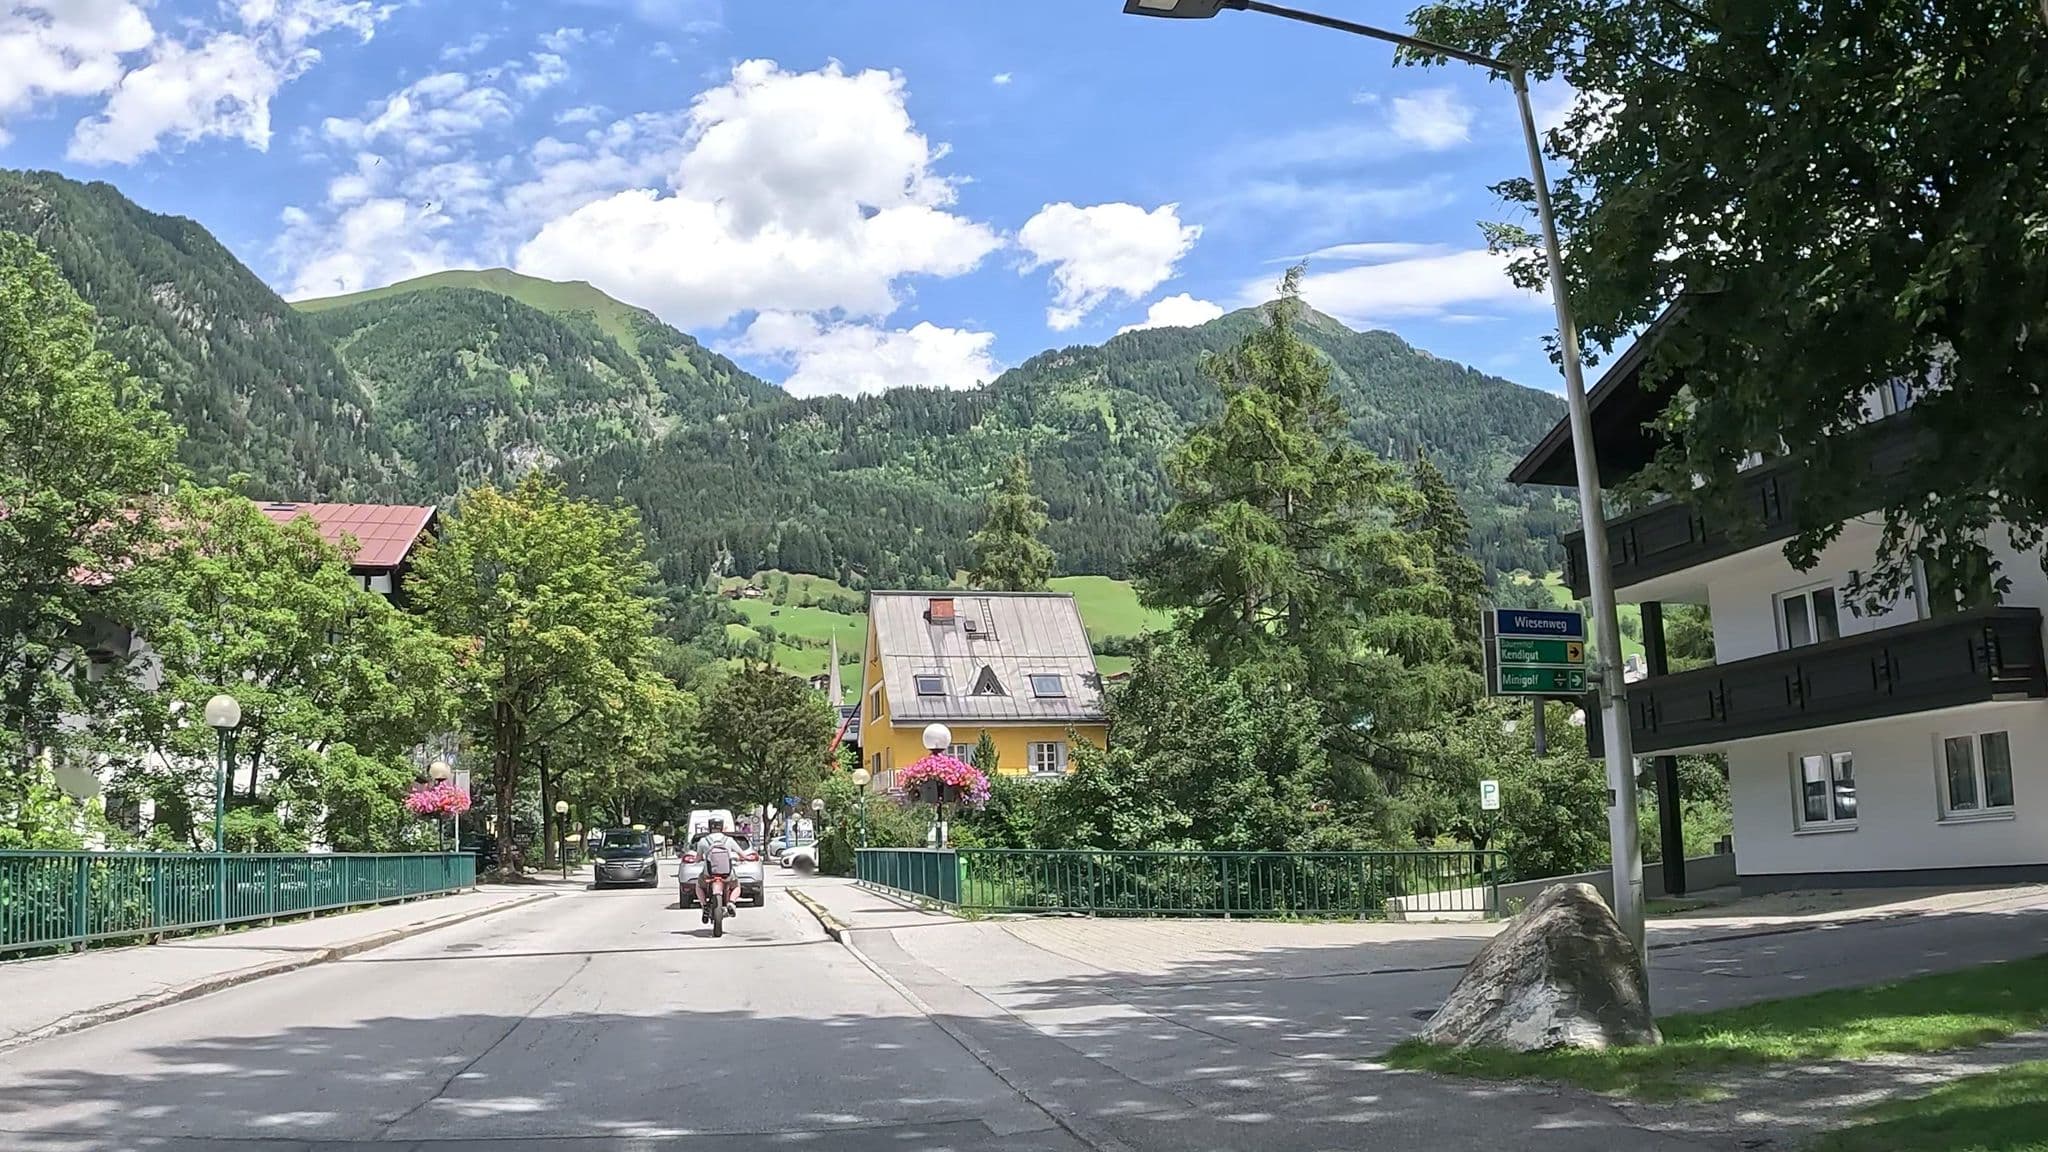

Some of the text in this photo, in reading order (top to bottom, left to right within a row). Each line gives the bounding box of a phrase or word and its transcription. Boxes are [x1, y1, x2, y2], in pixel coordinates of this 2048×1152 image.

[1514, 616, 1567, 632] Wiesenweg
[1501, 649, 1539, 662] Kendlgut
[1502, 673, 1539, 688] Minigolf
[1483, 784, 1496, 799] P
